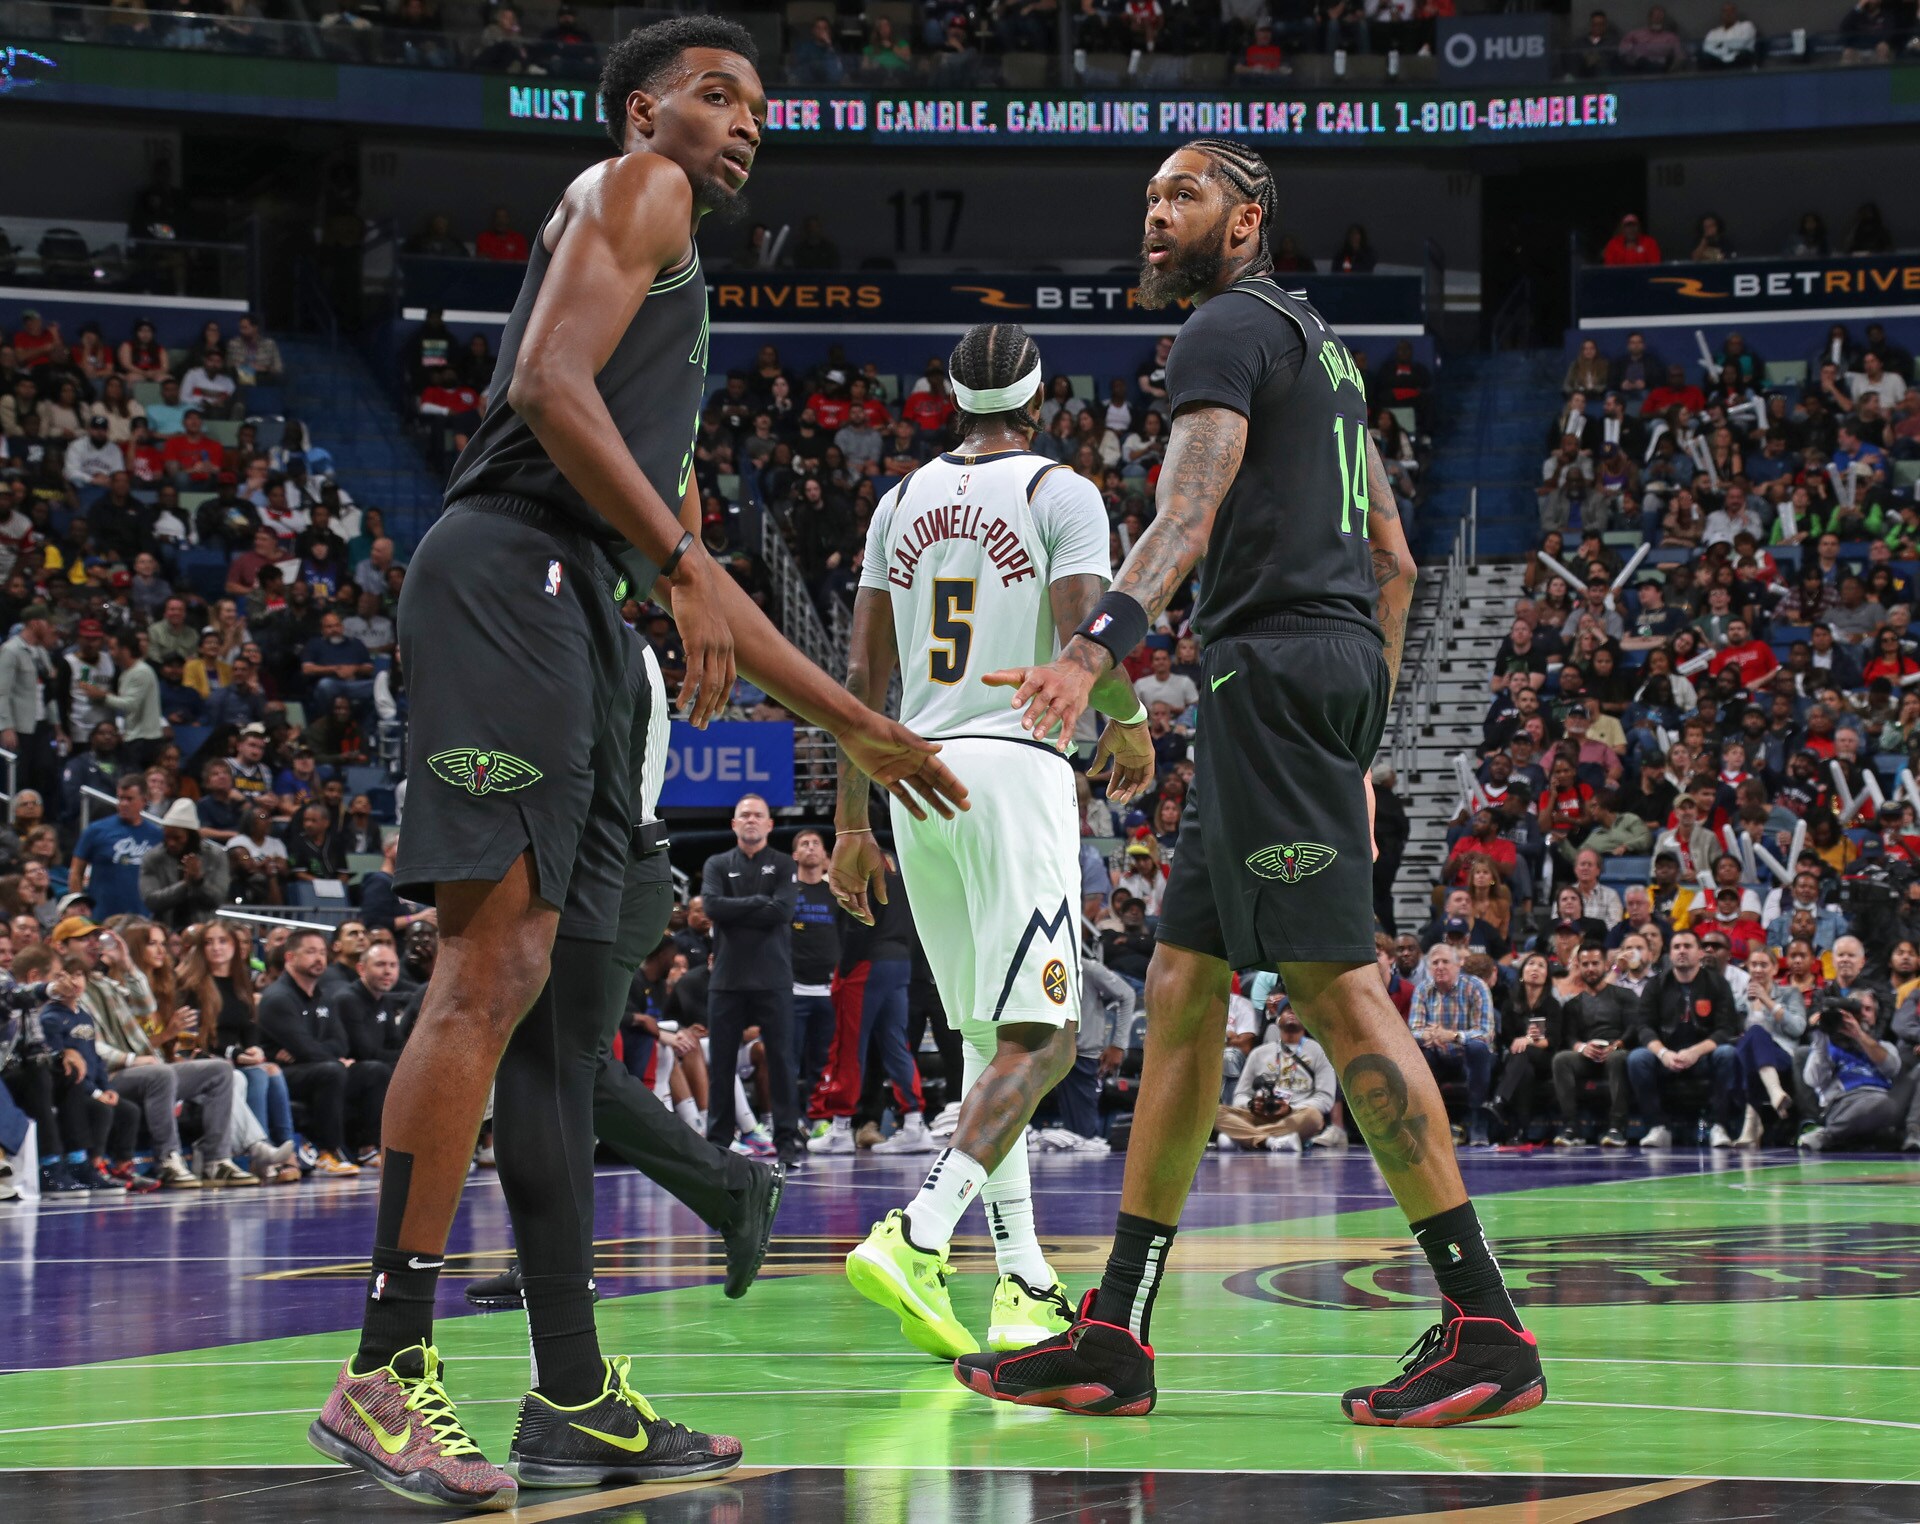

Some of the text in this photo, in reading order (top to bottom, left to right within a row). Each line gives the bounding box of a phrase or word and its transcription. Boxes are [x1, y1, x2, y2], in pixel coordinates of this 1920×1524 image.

[1484, 35, 1545, 60] HUB
[509, 85, 586, 122] MUST
[766, 93, 1618, 134] DER TO GAMBLE. GAMBLING PROBLEM? CALL 1-800-GAMBLER
[887, 190, 965, 254] 117
[706, 284, 882, 308] RIVERS
[1333, 412, 1370, 543] 14
[888, 504, 1037, 590] CALDWELL-POPE
[928, 577, 977, 687] 5
